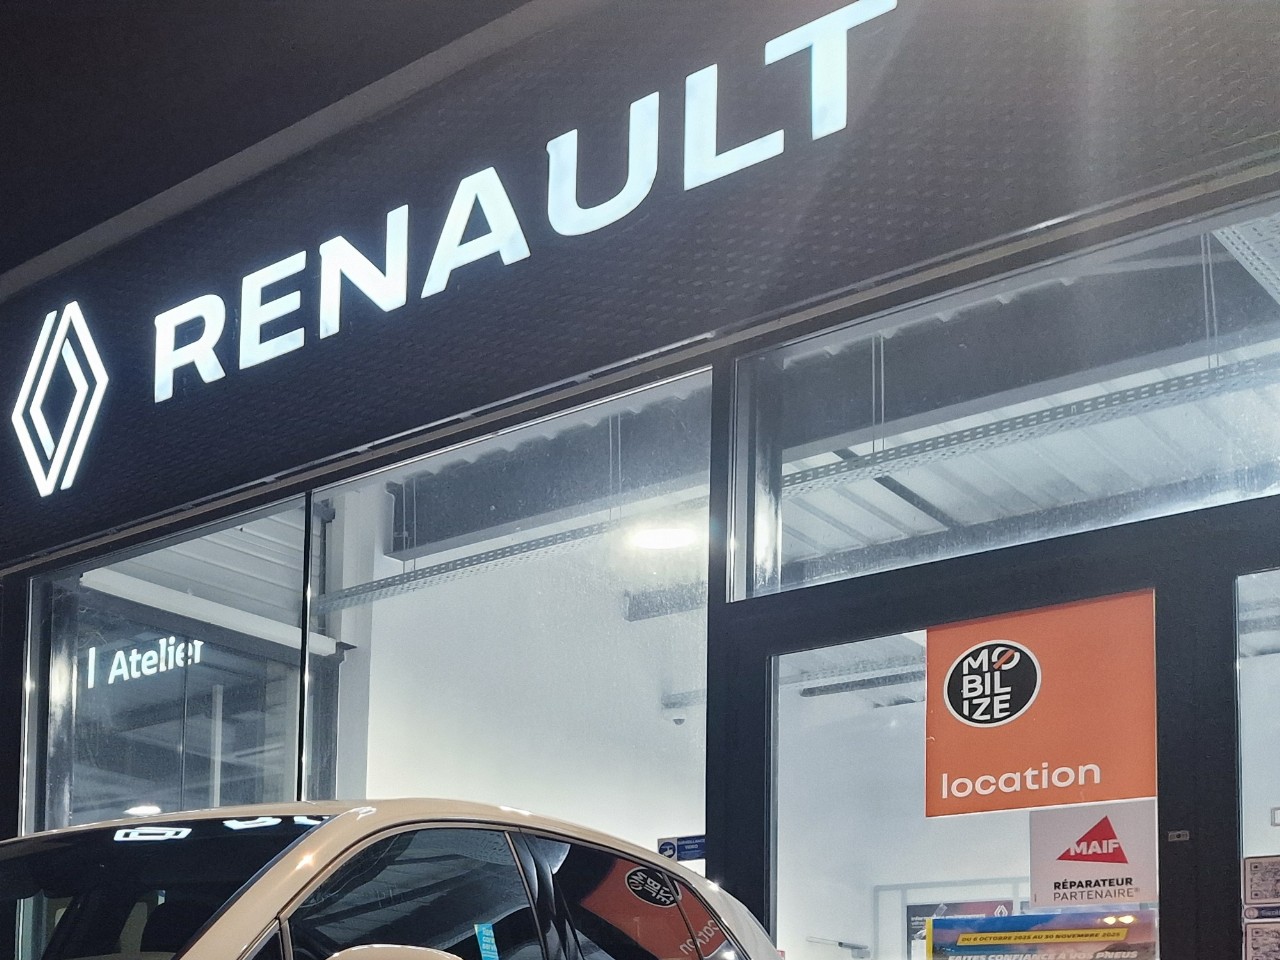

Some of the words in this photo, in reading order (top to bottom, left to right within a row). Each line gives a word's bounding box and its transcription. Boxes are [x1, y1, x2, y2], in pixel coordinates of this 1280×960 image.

[154, 0, 897, 405] RENAULT
[107, 635, 204, 685] Atelier
[962, 671, 1012, 699] BIL
[962, 694, 1011, 721] IZE
[941, 762, 1101, 799] location
[1070, 838, 1120, 857] MAIF
[1053, 877, 1133, 891] RÉPARATEUR
[1069, 952, 1094, 960] VOS
[1095, 950, 1139, 959] PNEUS
